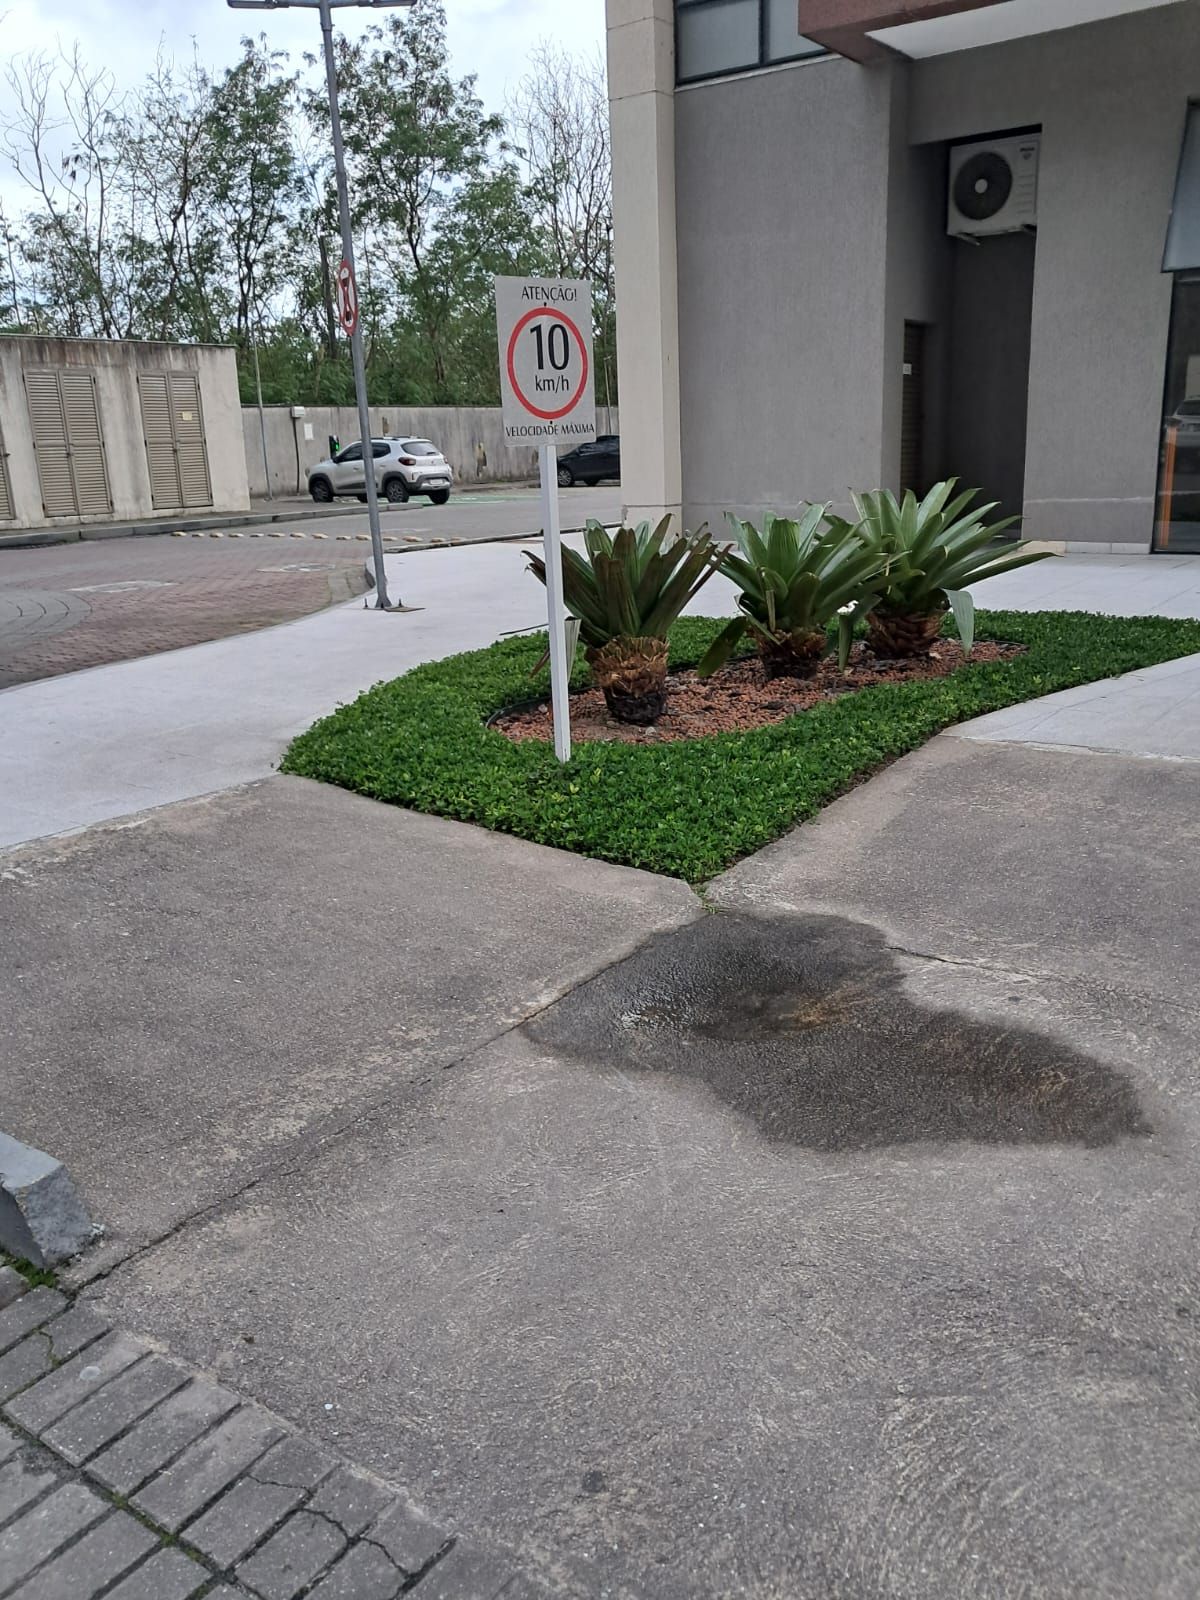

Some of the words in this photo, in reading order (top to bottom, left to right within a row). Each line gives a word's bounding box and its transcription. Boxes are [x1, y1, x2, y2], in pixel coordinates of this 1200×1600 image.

[521, 284, 577, 303] ATENÇÃO!
[530, 323, 570, 370] 10
[535, 375, 569, 393] km/h
[506, 424, 559, 437] VELOCIDADE
[561, 422, 595, 434] MÁXIMA
